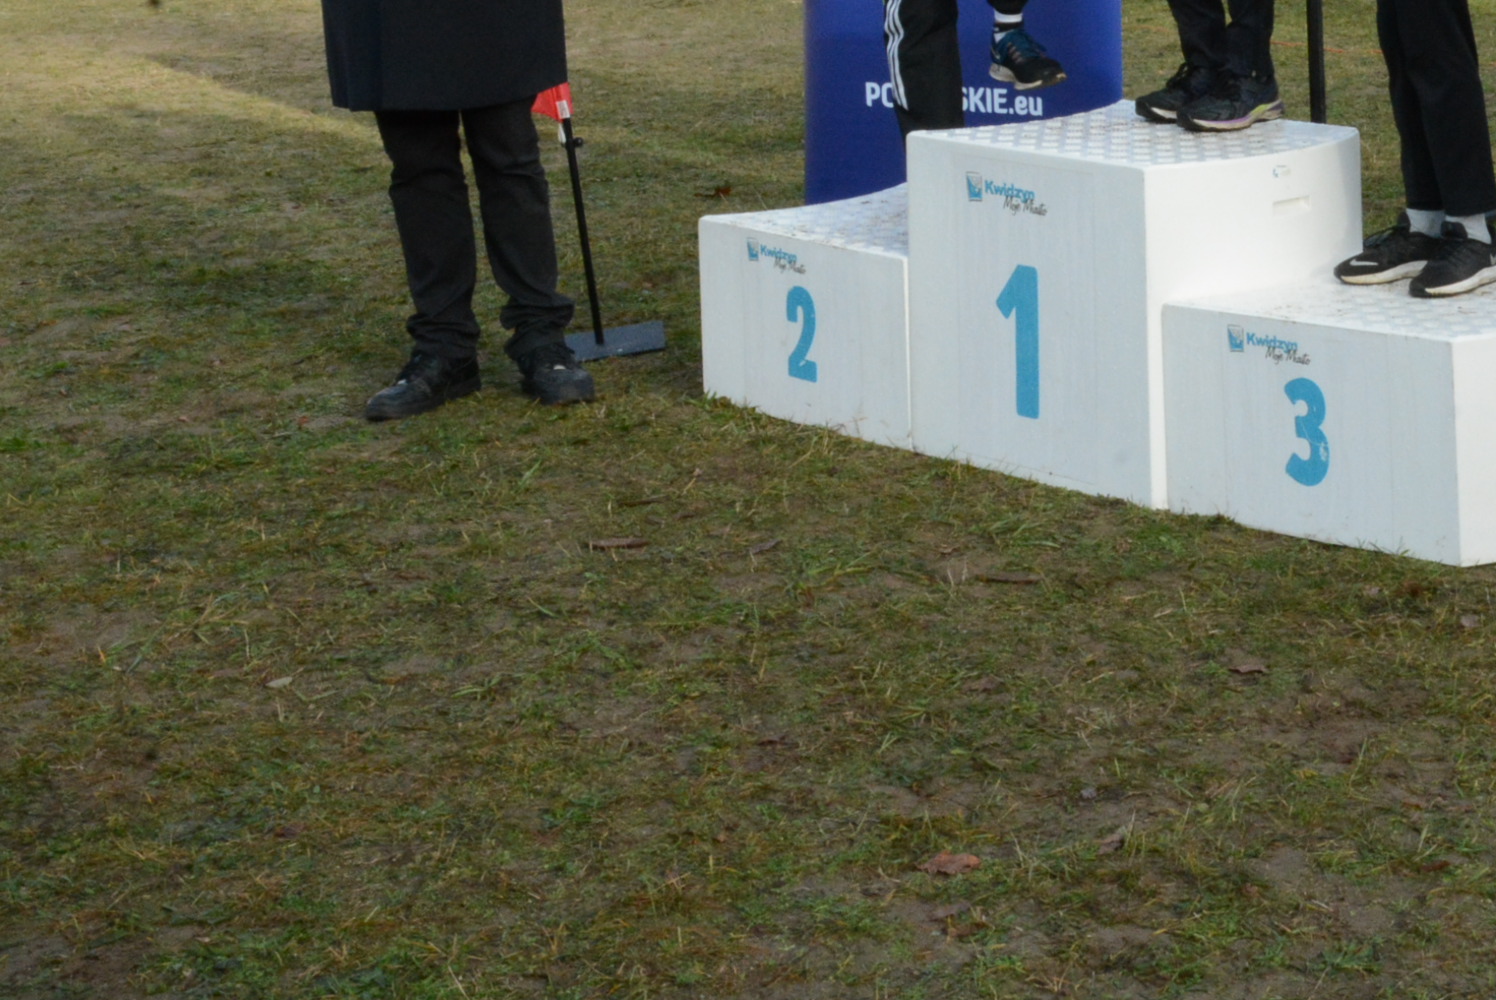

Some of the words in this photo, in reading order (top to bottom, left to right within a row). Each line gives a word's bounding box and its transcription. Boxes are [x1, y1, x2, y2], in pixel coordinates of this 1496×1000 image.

[984, 179, 1036, 203] Kwidzyn
[786, 285, 818, 384] 2
[996, 264, 1040, 420] 1
[1246, 331, 1299, 354] Kwidzyn
[1284, 377, 1330, 487] 3
